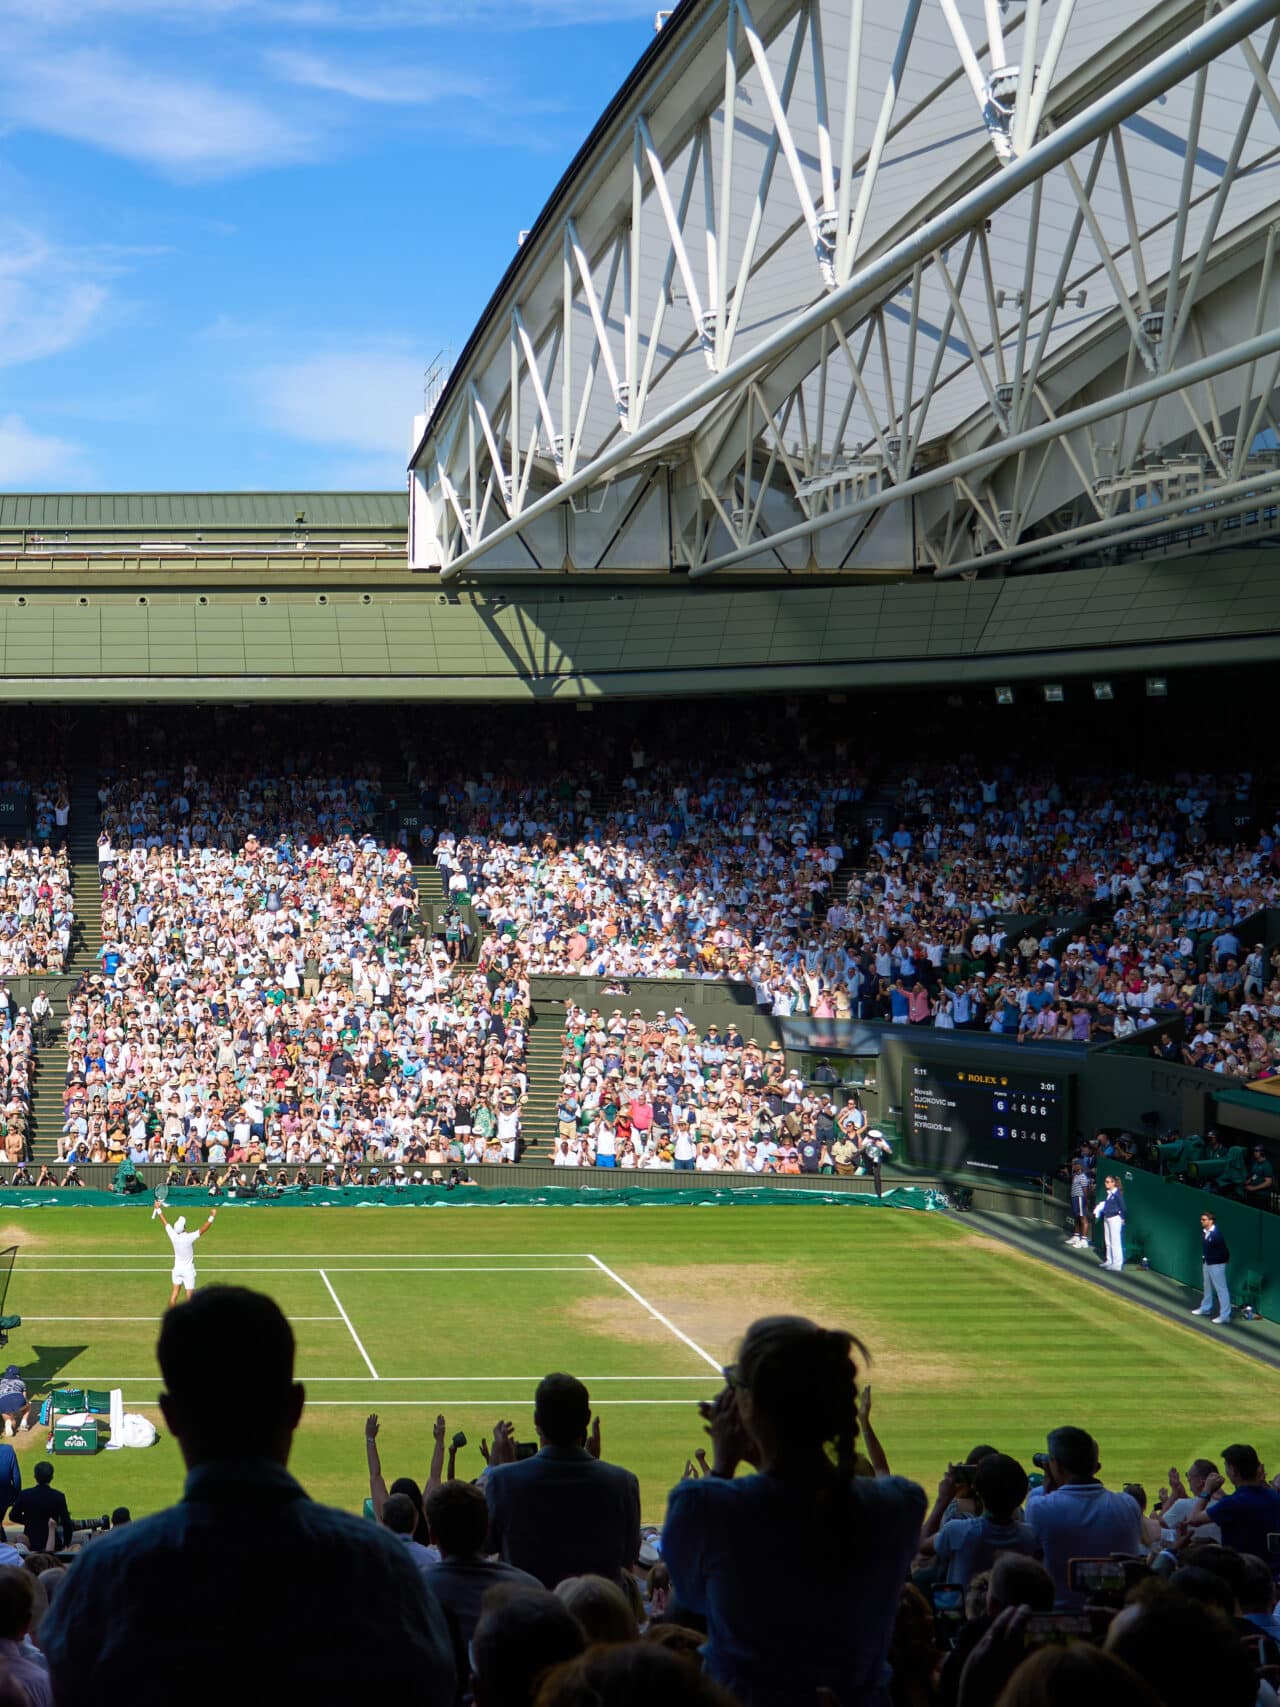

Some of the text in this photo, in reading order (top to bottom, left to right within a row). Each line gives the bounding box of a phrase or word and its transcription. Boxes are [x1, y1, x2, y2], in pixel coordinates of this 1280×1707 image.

[0, 803, 15, 812] 314
[403, 817, 418, 826] 315
[968, 1073, 997, 1084] ROLEX
[1040, 1082, 1055, 1091] 3:01
[914, 1087, 933, 1096] Novak
[914, 1095, 946, 1106] DJOKOVIC
[997, 1101, 1047, 1116] 6 4 6 6 6
[914, 1121, 942, 1131] KYRGIOS
[997, 1127, 1047, 1142] 3 6 3 4 6
[64, 1439, 87, 1447] evian
